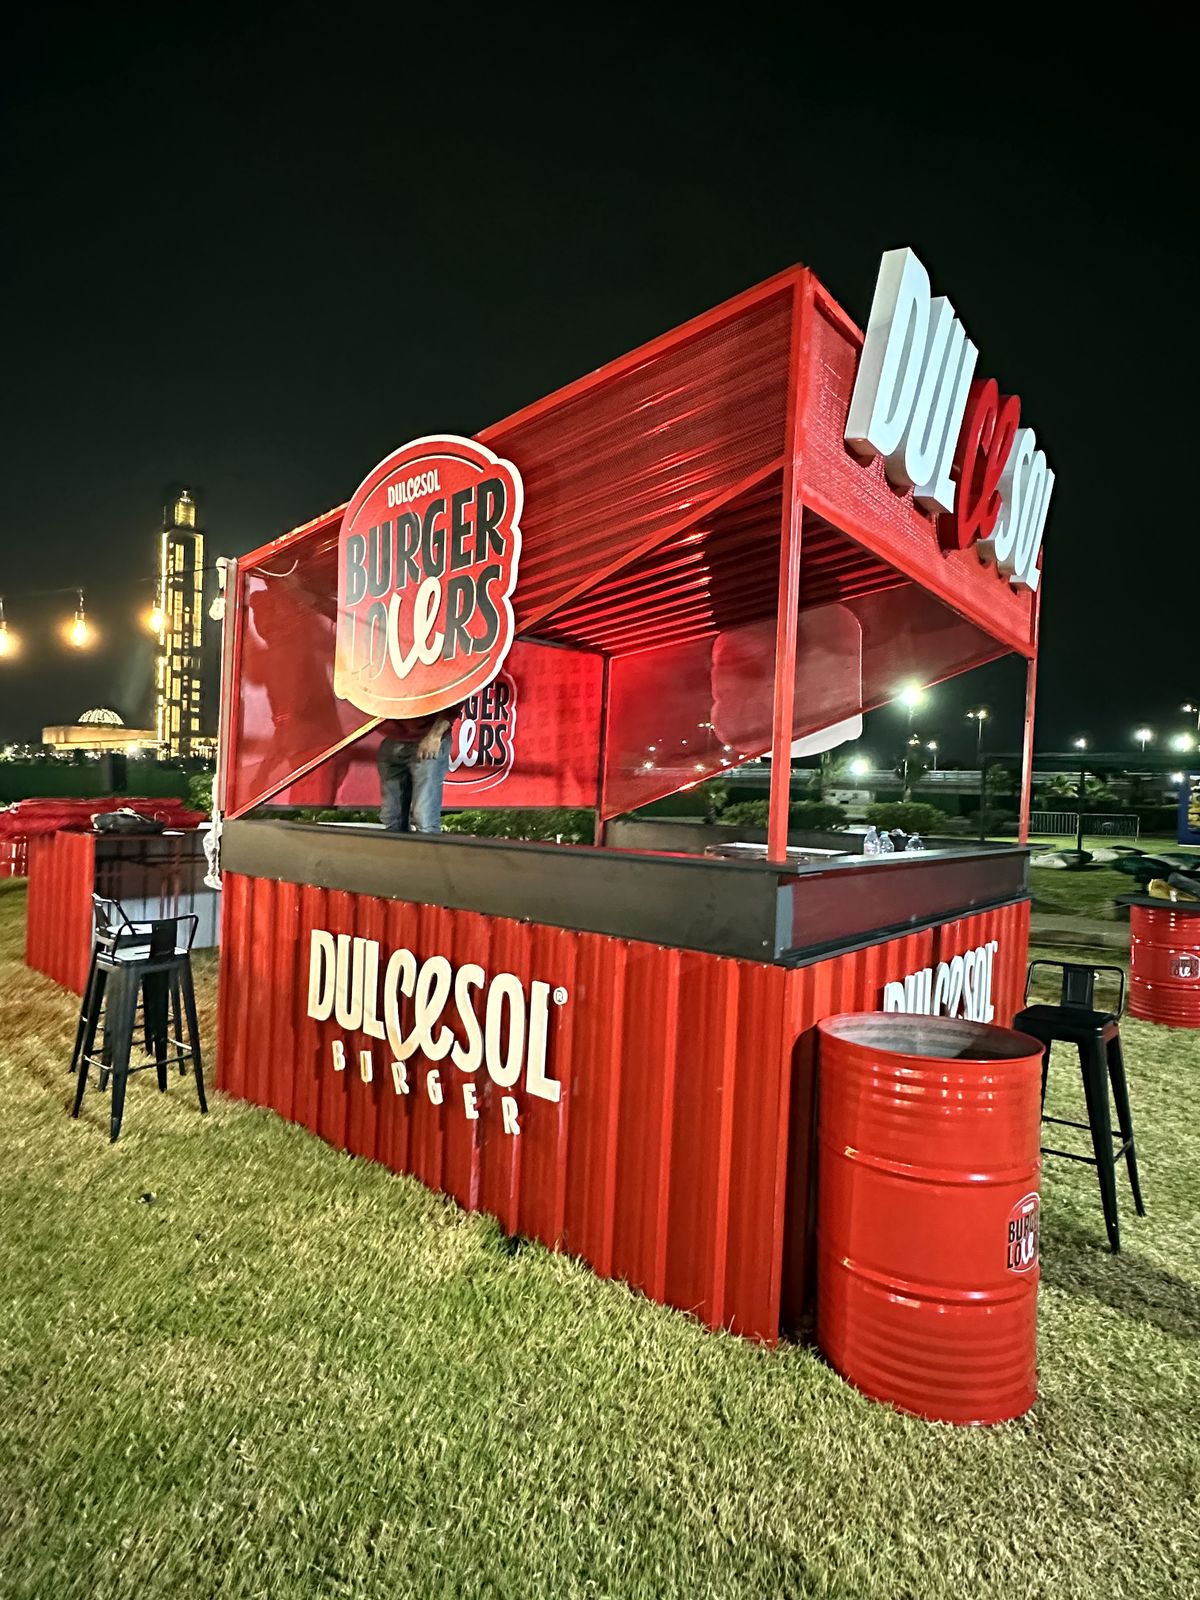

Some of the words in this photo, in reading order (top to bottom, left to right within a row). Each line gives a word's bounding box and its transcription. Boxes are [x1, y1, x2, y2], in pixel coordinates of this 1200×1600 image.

[345, 477, 508, 607] BURGER
[461, 681, 511, 722] GER
[331, 1040, 521, 1136] BURGER
